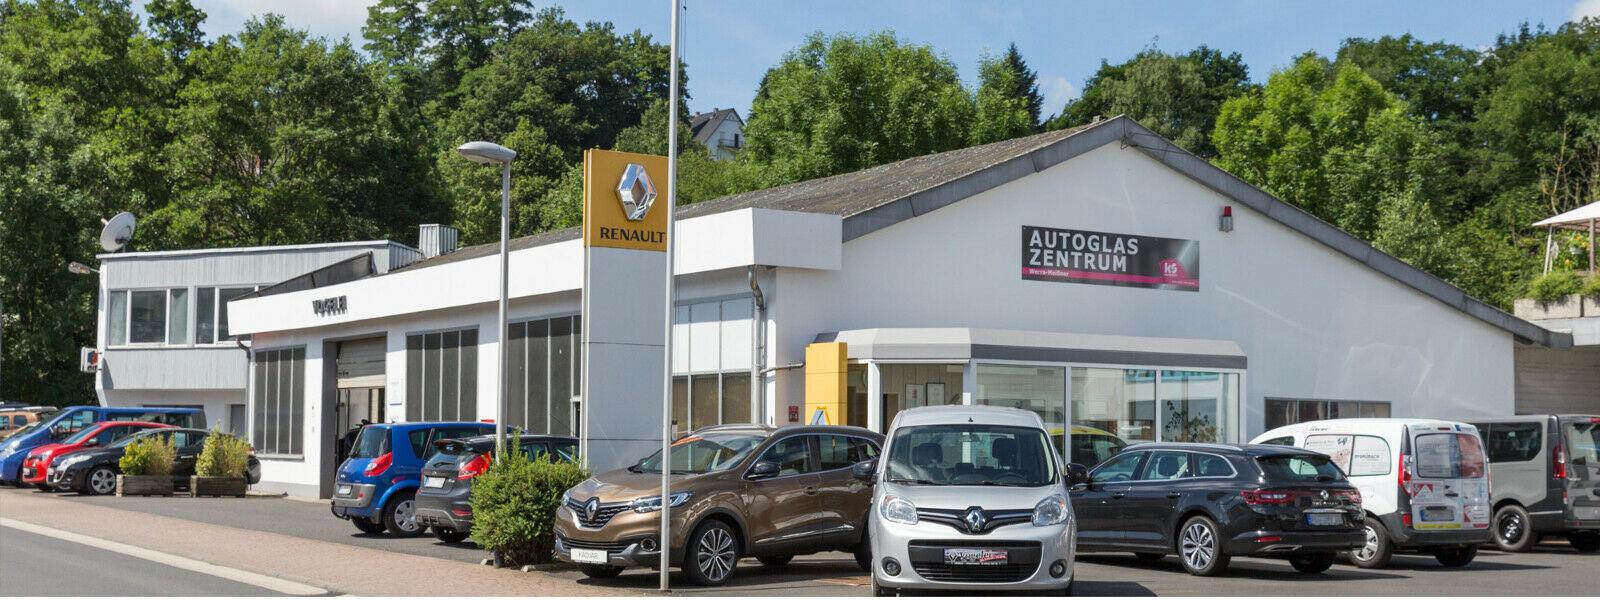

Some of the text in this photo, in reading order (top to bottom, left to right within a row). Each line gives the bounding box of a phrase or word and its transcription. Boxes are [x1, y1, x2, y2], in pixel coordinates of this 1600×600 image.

[600, 227, 666, 243] RENAULT
[1029, 230, 1139, 255] AUTOGLAS
[1029, 249, 1127, 272] ZENTRUM
